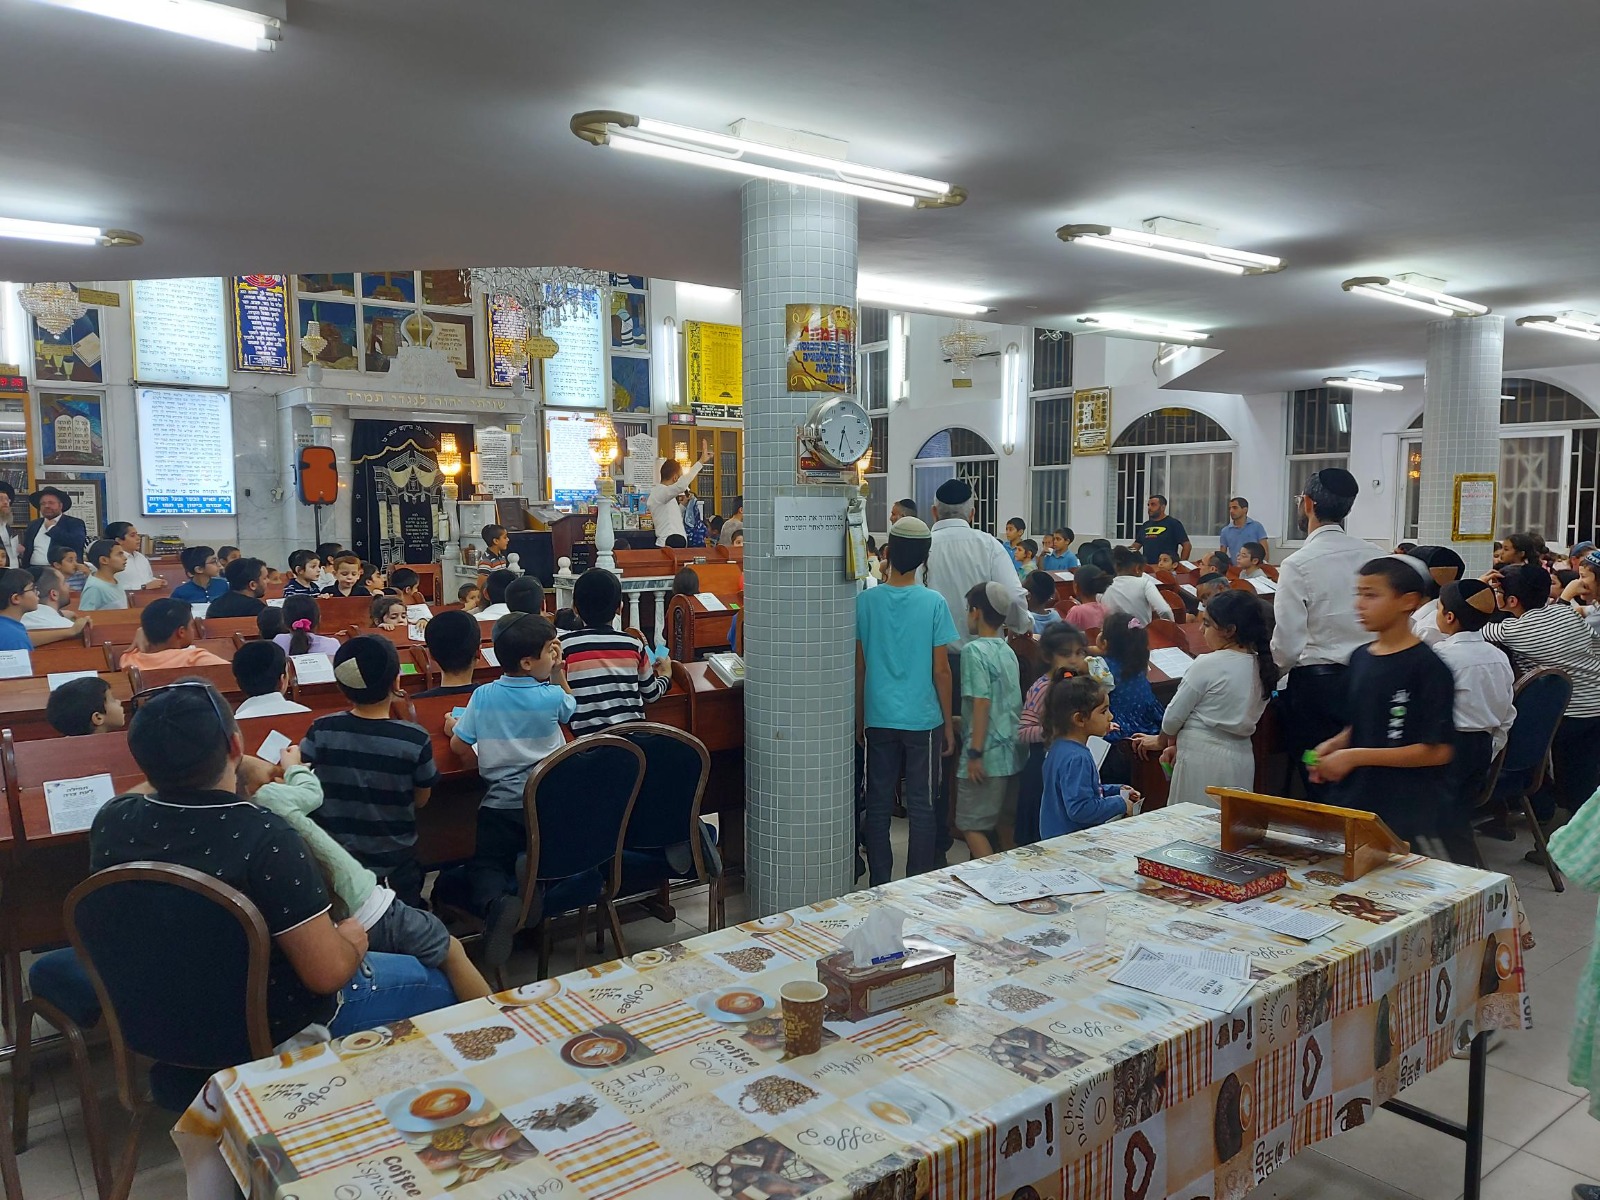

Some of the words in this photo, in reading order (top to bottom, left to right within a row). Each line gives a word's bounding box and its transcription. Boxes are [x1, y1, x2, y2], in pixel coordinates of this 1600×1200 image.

[346, 391, 384, 402] תמיד
[391, 394, 427, 405] לנגדי
[470, 400, 506, 410] שויתי
[808, 522, 825, 531] לאחר
[617, 983, 654, 1015] Coffee
[715, 1038, 761, 1067] Coffee
[610, 1065, 666, 1091] CAFÉ
[283, 1075, 348, 1121] Coffee
[591, 1080, 646, 1117] Espresso
[1078, 1070, 1109, 1148] Dalmatian
[796, 1126, 888, 1153] Coffee
[382, 1155, 422, 1199] Coffee
